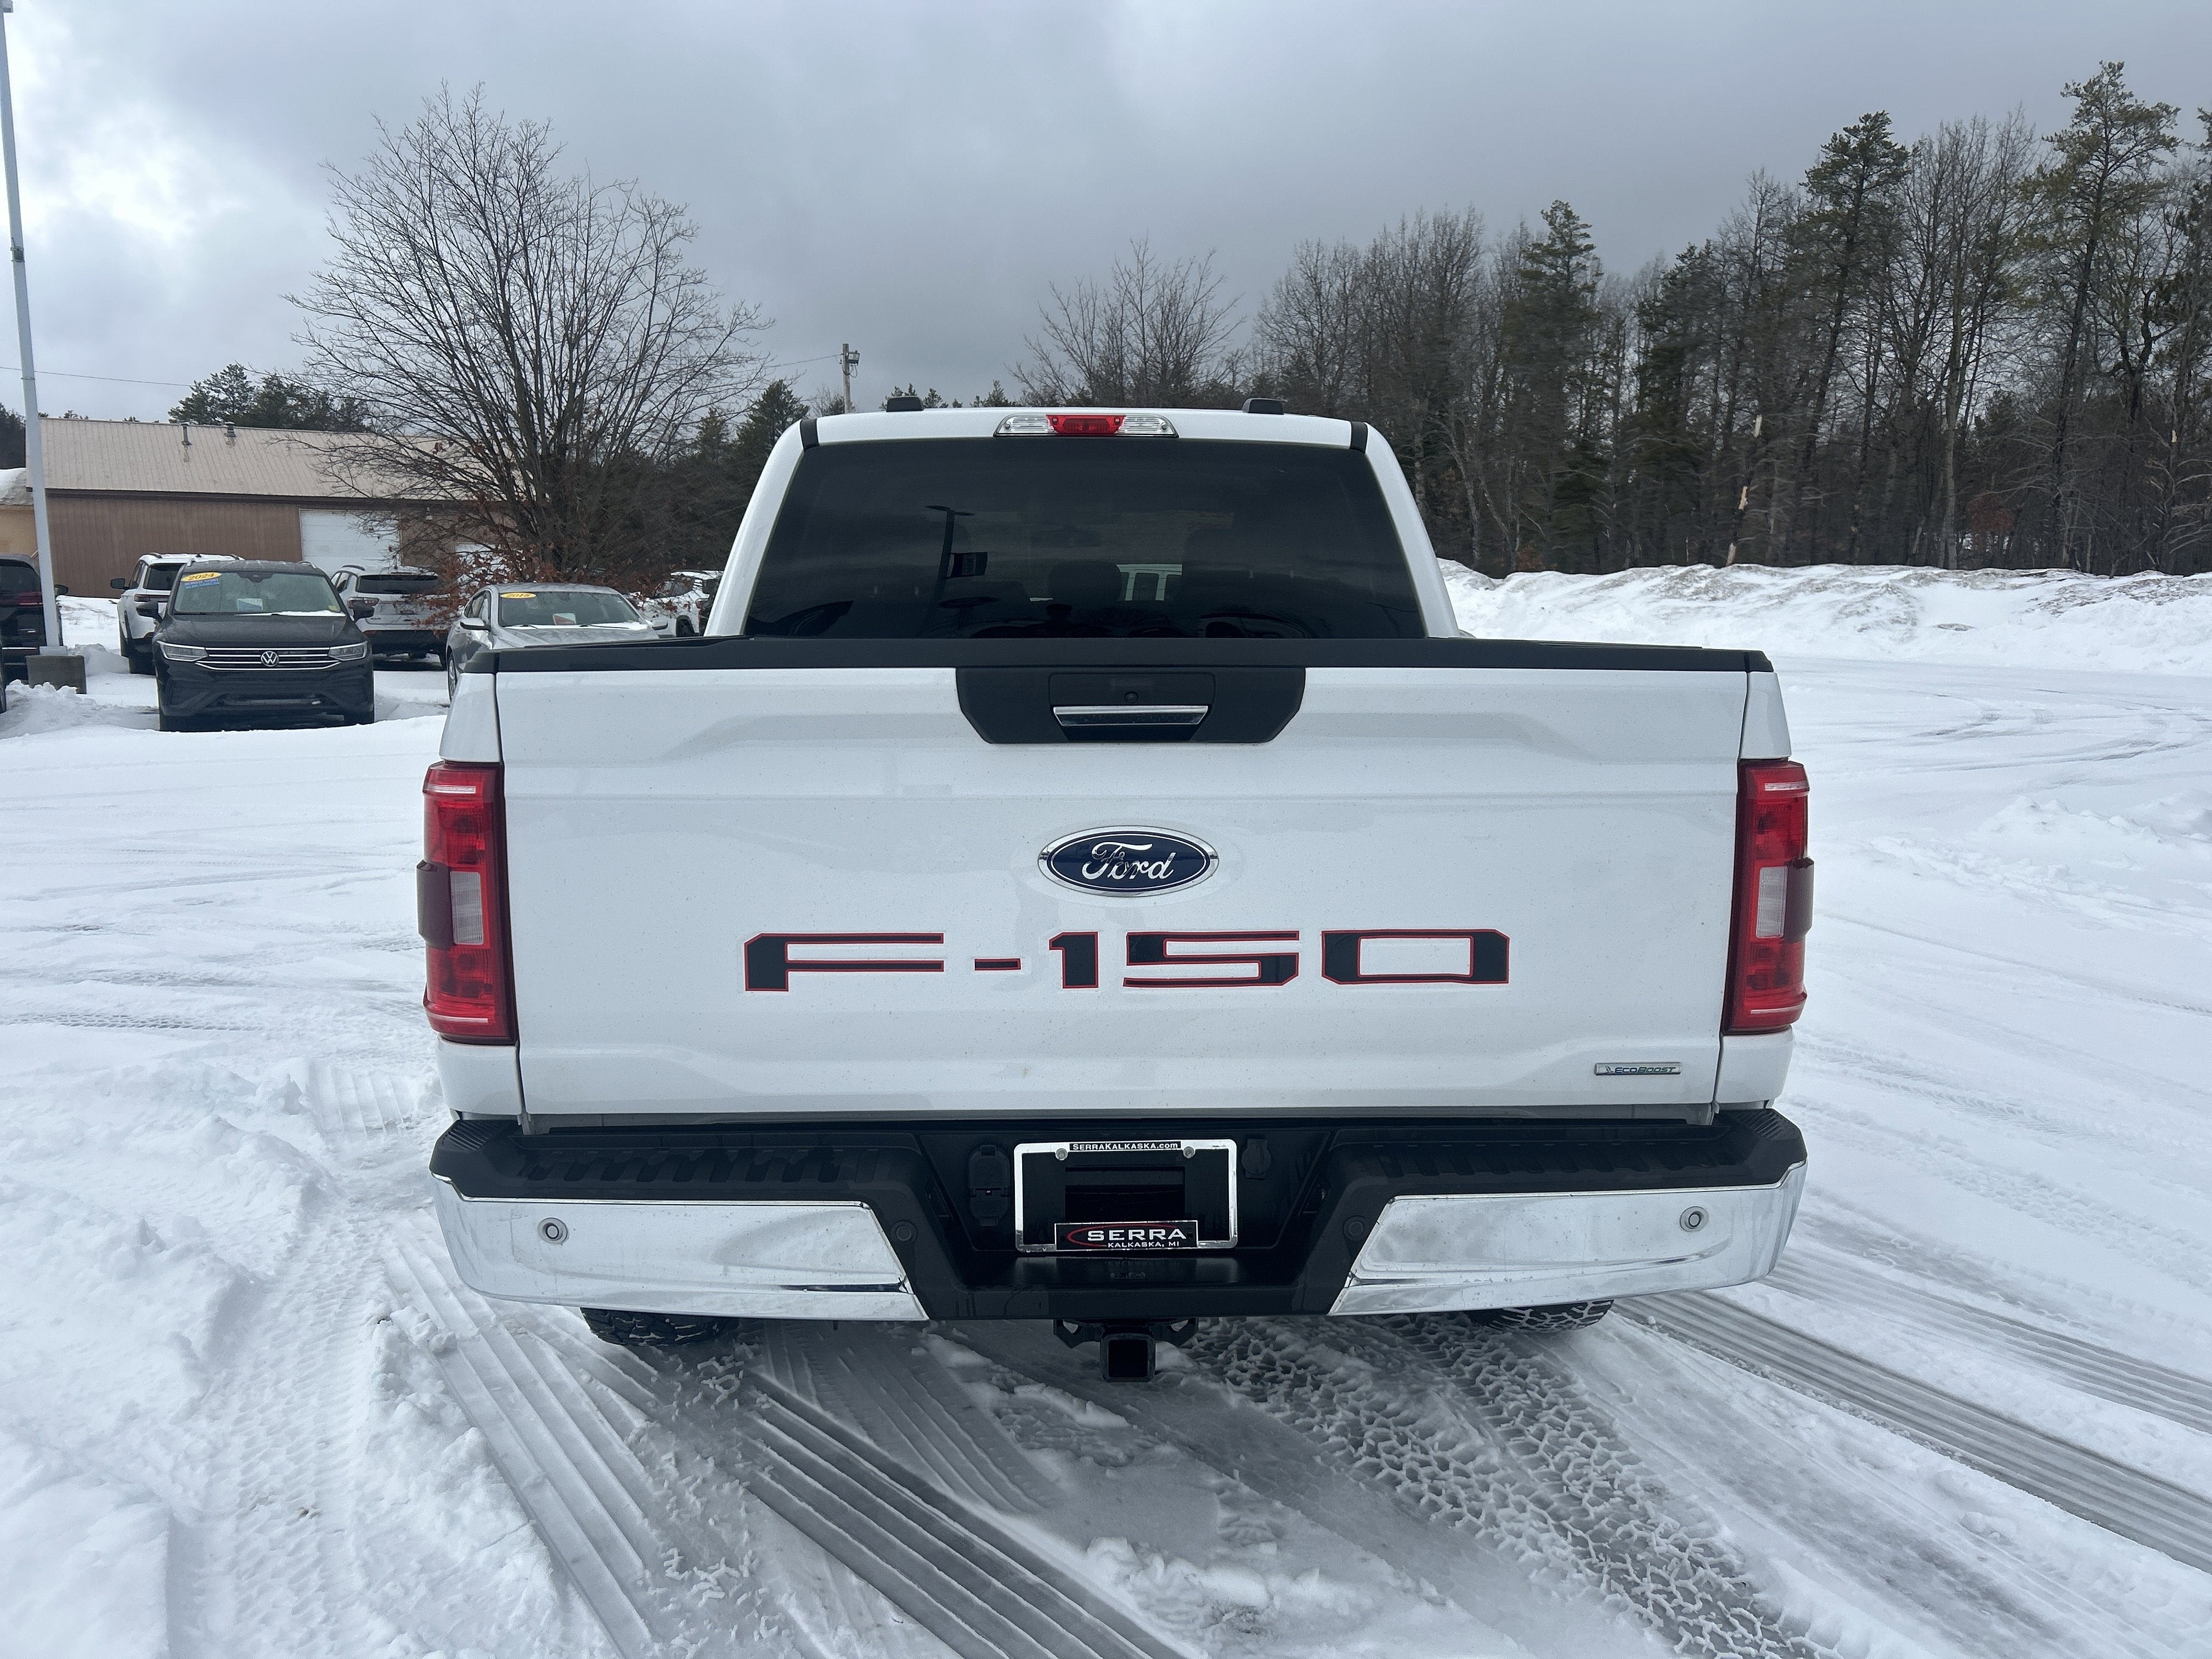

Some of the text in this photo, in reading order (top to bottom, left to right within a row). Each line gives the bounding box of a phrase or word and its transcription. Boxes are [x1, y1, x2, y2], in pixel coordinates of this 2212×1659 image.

[1082, 842, 1176, 879] Ford
[744, 928, 1510, 991] F-150
[1087, 1228, 1187, 1241] SERRA
